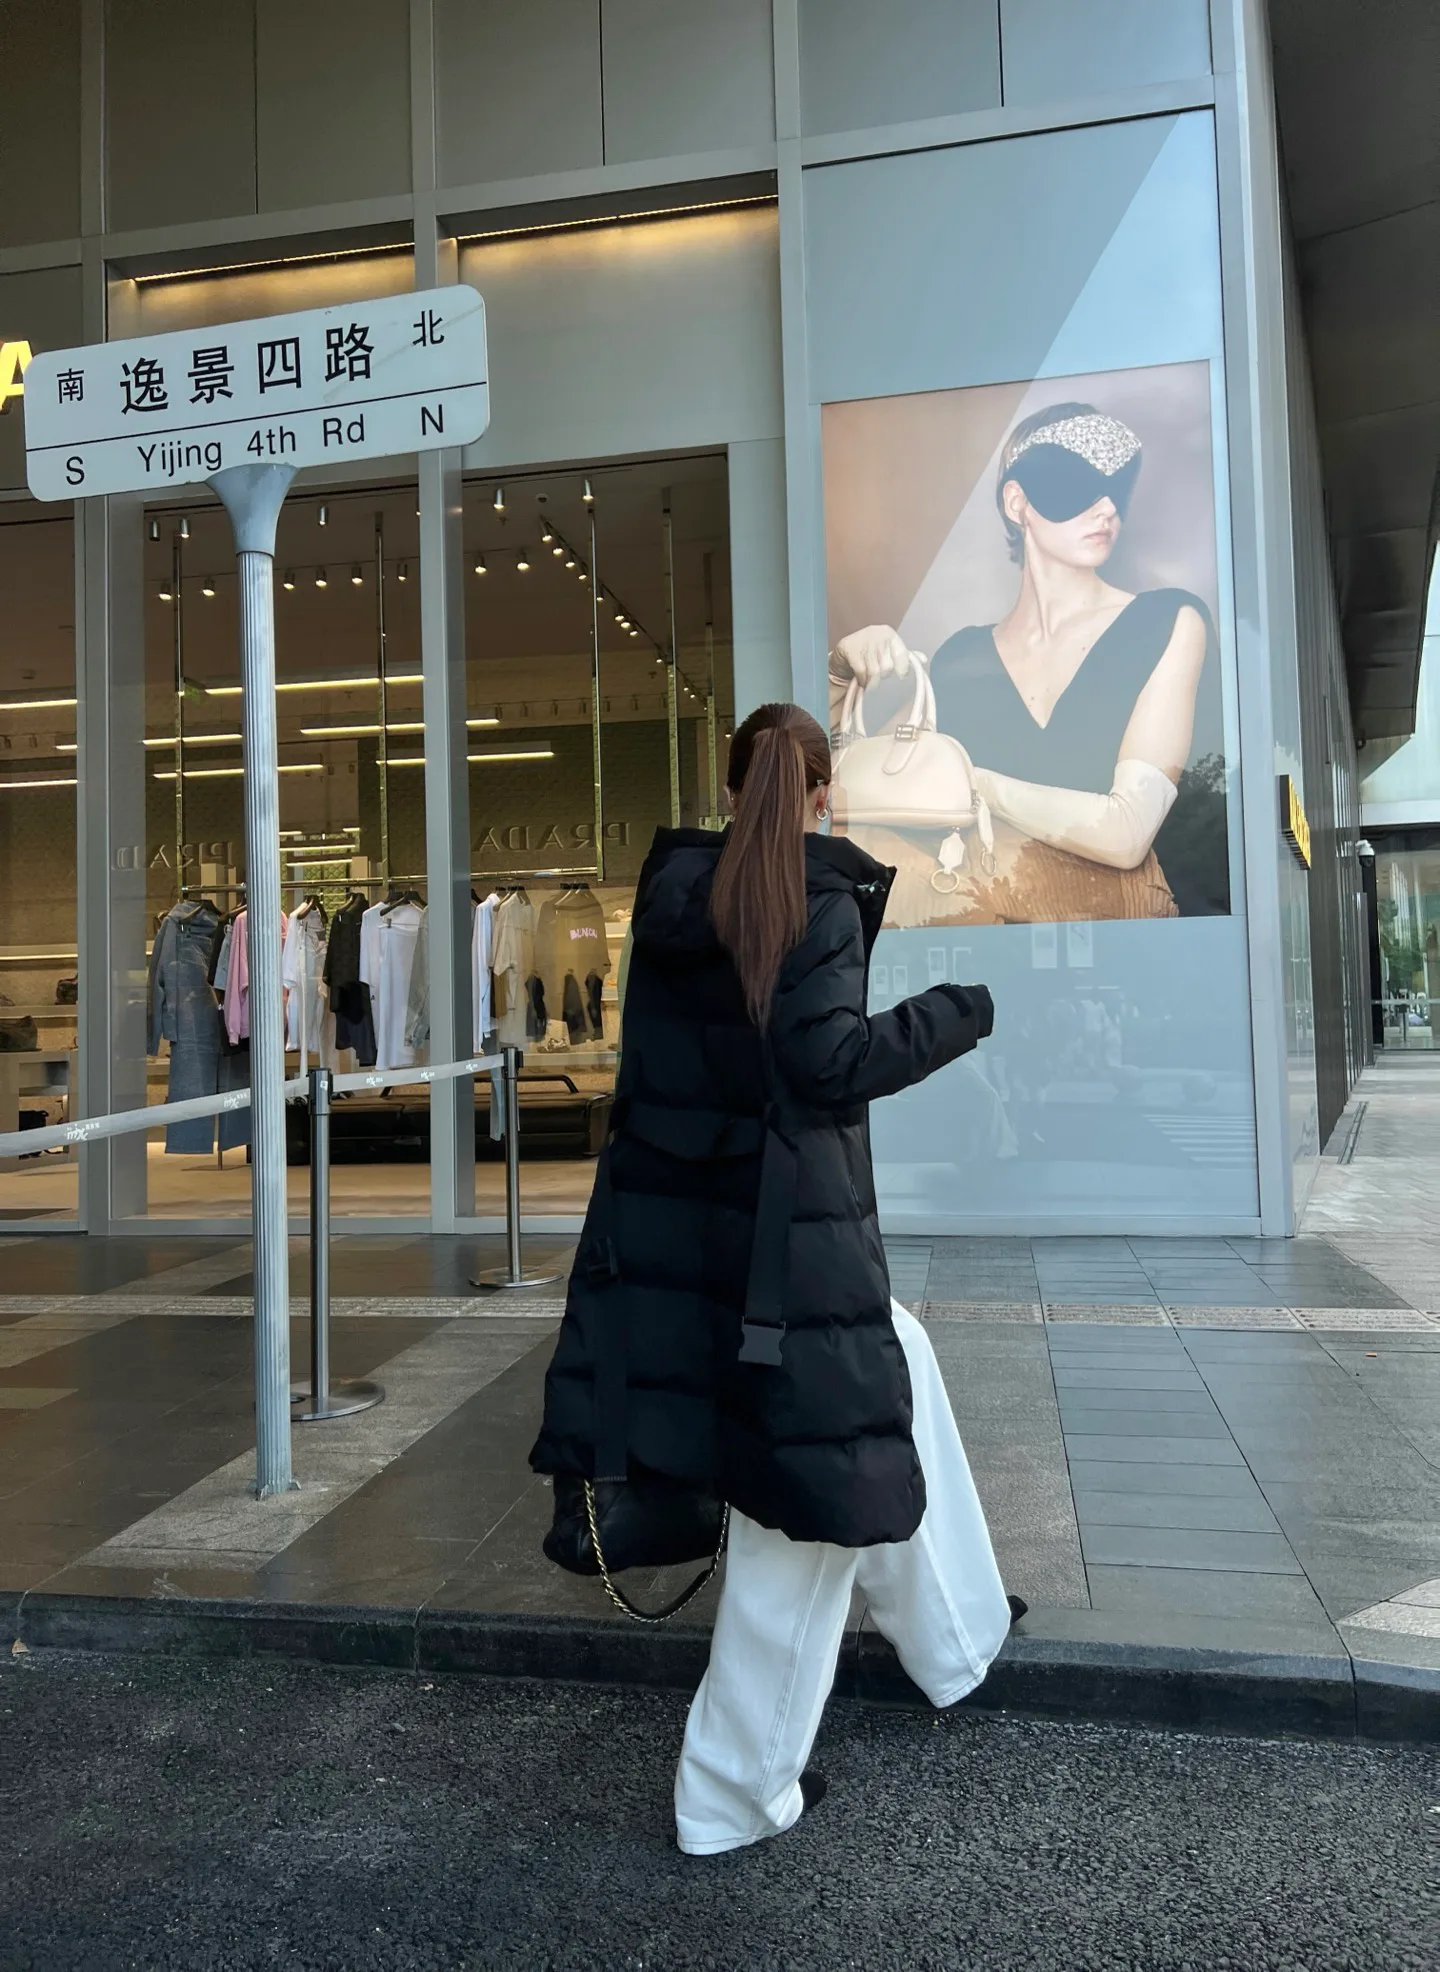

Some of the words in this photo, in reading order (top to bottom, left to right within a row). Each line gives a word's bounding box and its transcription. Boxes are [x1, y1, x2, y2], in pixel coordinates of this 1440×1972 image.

[56, 368, 85, 404] 南
[120, 322, 375, 414] 逸景四路
[412, 310, 445, 347] 北
[65, 456, 85, 486] S
[137, 440, 222, 477] Yijing
[247, 425, 296, 457] 4th
[322, 414, 365, 447] Rd
[421, 404, 444, 436] N
